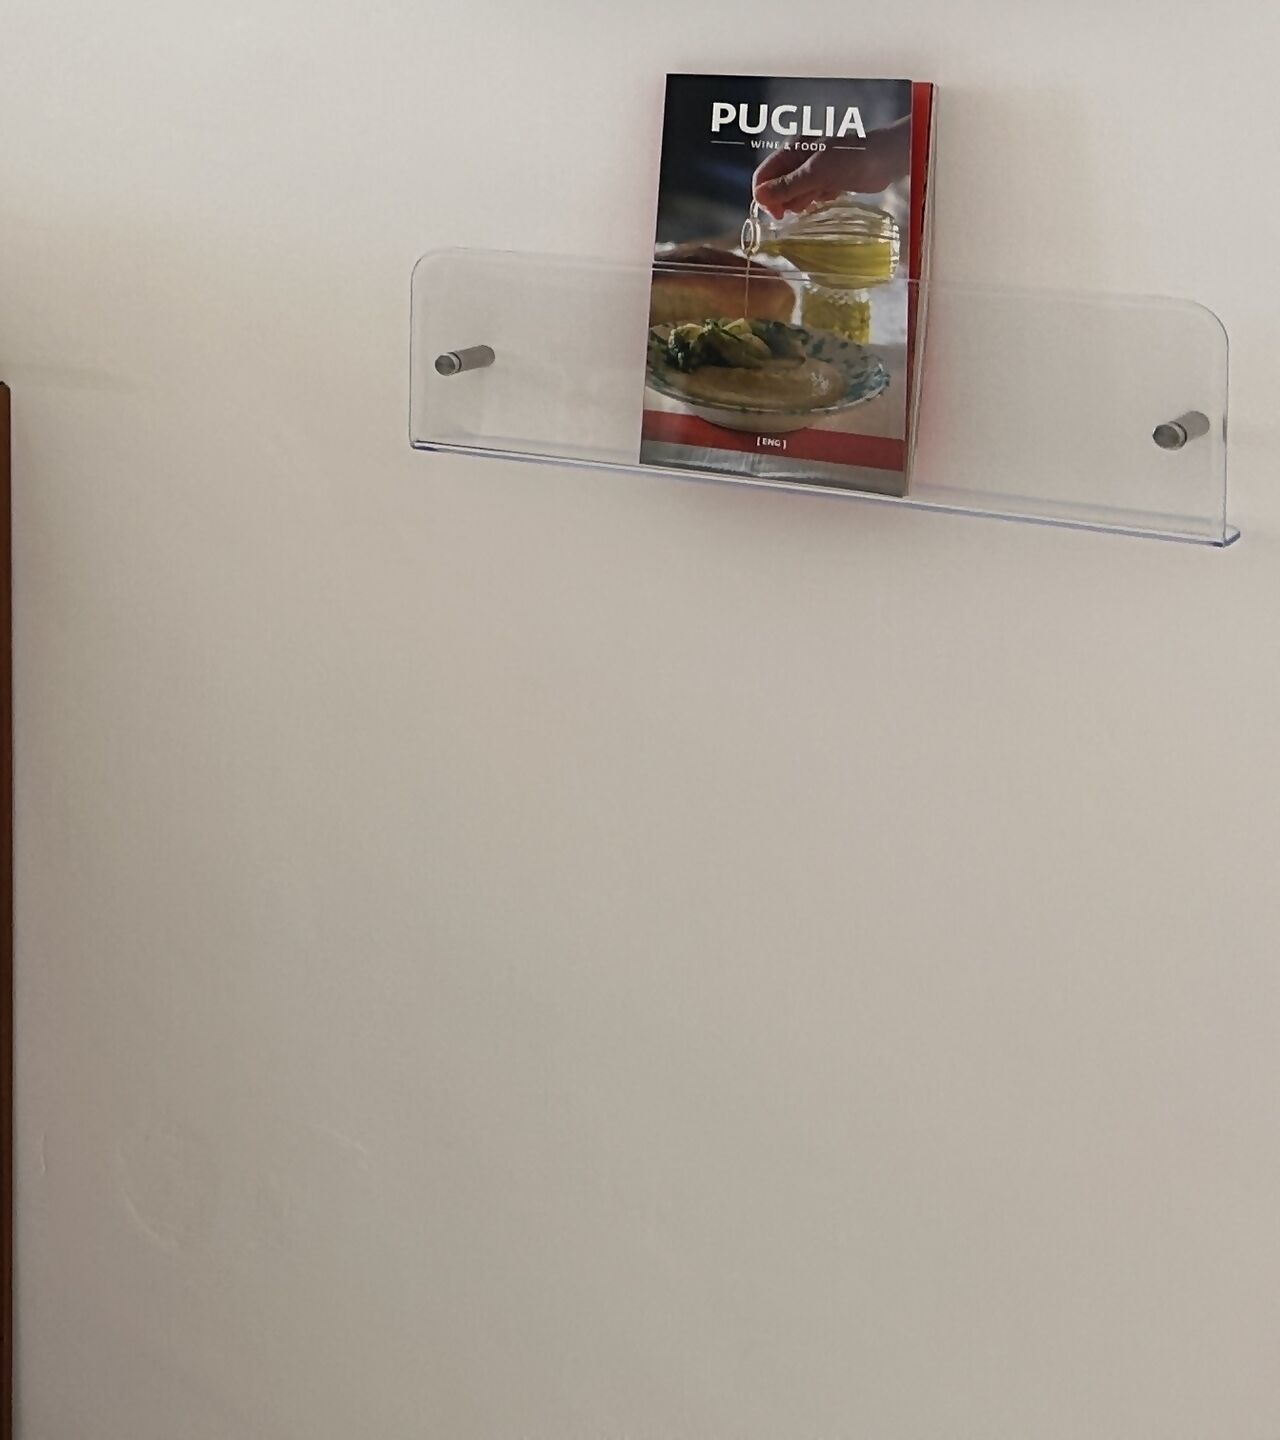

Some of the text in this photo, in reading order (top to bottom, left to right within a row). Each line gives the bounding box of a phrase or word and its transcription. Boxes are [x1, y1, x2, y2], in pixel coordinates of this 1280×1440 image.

[711, 102, 867, 139] PUGLIA
[750, 139, 780, 150] WINE
[794, 141, 826, 152] FOOD
